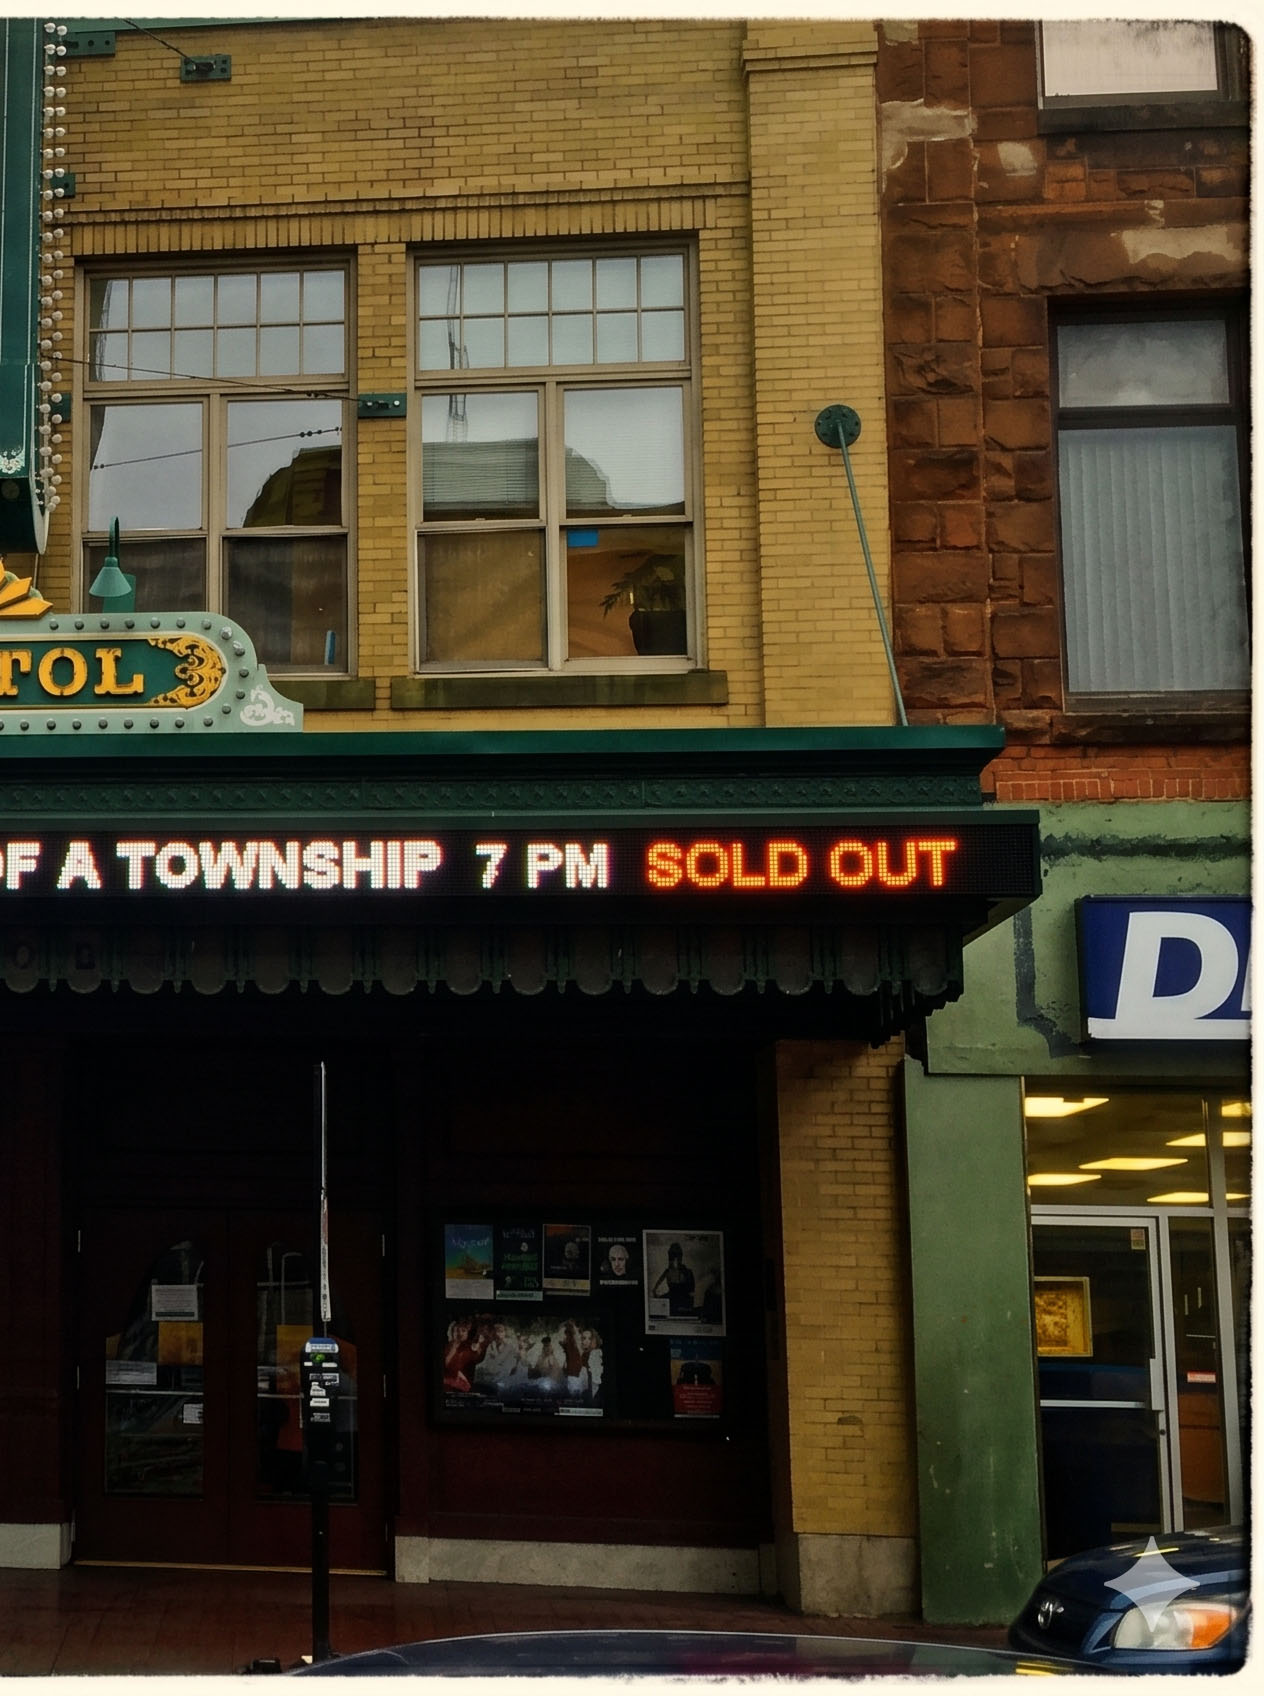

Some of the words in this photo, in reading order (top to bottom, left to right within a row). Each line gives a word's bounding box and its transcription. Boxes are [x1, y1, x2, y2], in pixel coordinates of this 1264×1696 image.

[56, 840, 102, 889] A
[116, 839, 443, 890] TOWNSHIP
[475, 842, 509, 889] 7
[527, 842, 610, 889] PM
[645, 839, 810, 889] SOLD
[829, 837, 958, 888] OUT
[1112, 911, 1252, 1021] D
